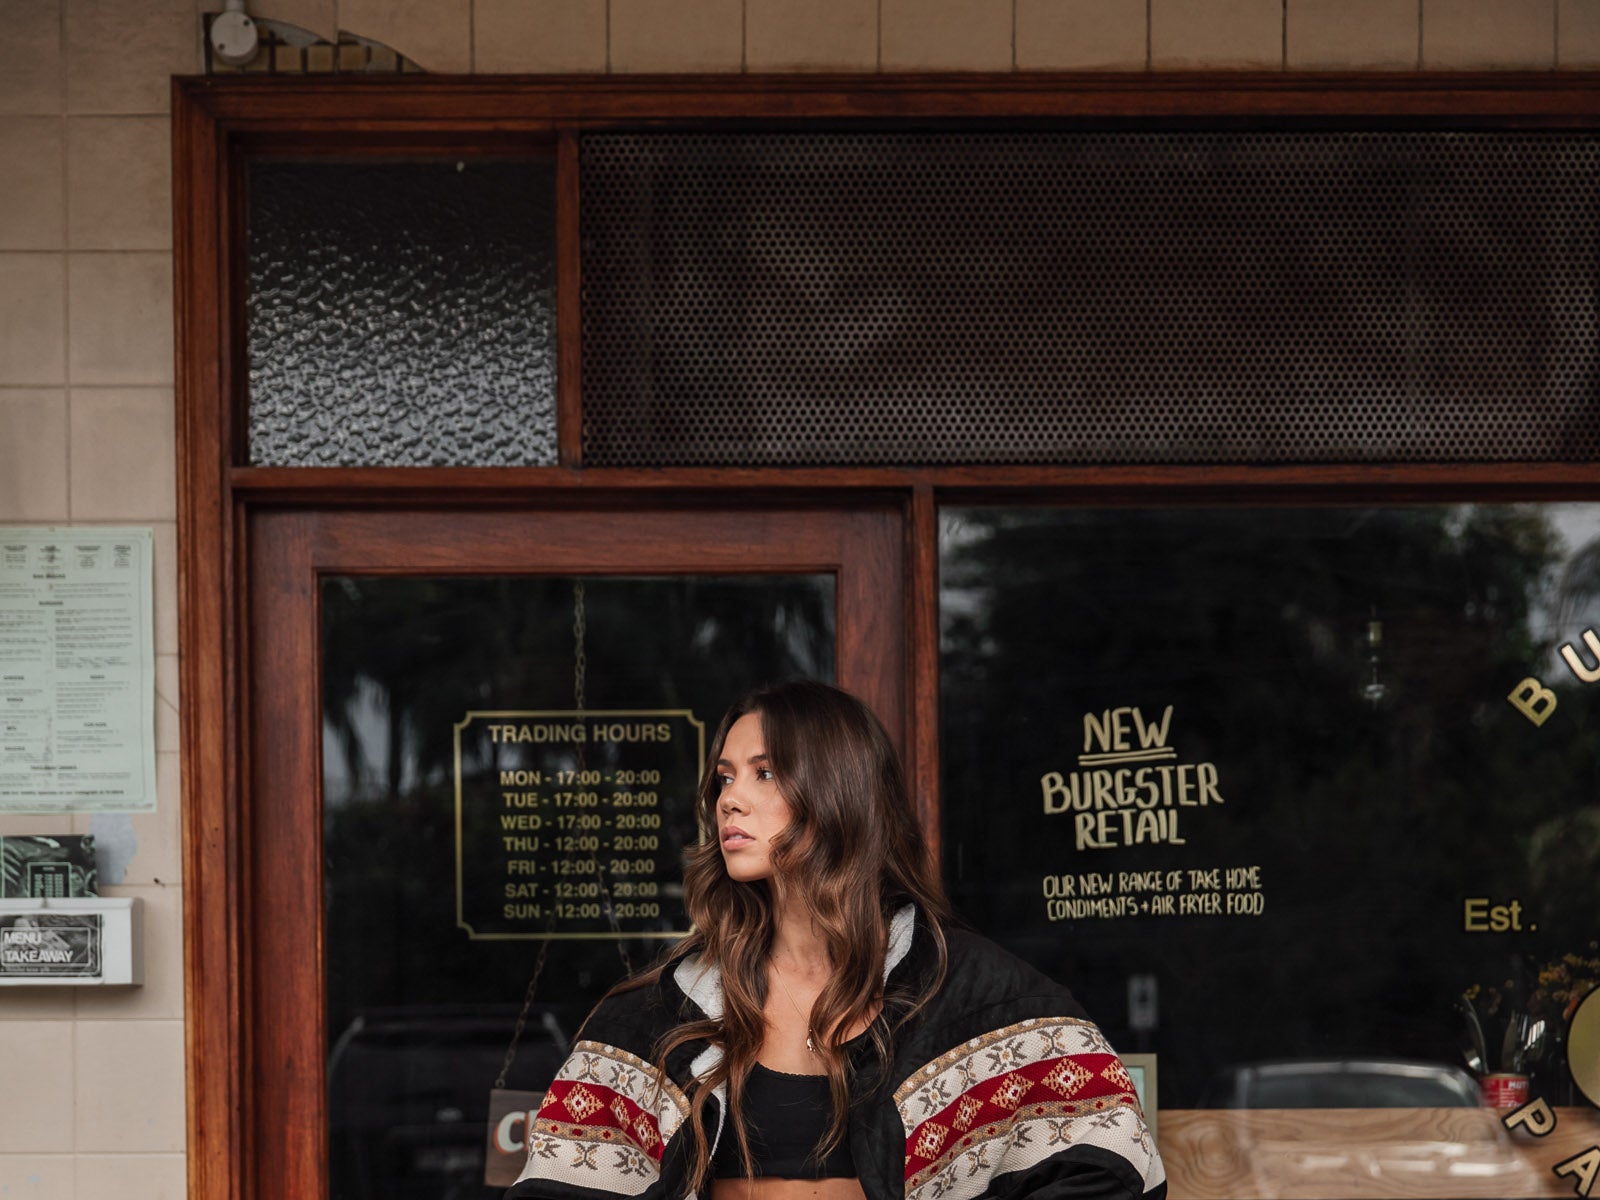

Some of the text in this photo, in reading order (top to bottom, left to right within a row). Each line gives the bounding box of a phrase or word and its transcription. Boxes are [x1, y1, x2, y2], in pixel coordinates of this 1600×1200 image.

[488, 723, 672, 743] TRADING HOURS
[1083, 705, 1174, 752] NEW
[500, 770, 541, 786] MON
[557, 769, 601, 786] 17:00
[615, 770, 660, 785] 20:00
[1041, 762, 1225, 814] BURGSTER
[503, 792, 538, 808] TUE
[554, 792, 598, 807] 17:00
[613, 792, 657, 806] 20:00
[501, 815, 541, 830] WED
[558, 815, 601, 829] 17:00
[616, 815, 660, 829] 20:00
[1074, 809, 1186, 850] RETAIL
[503, 837, 538, 851] THU
[556, 837, 598, 851] 12:00
[614, 836, 658, 850] 20:00
[507, 860, 535, 874] FRI
[552, 860, 595, 874] 12:00
[611, 860, 654, 873] 20:00
[505, 883, 538, 897] SAT
[555, 883, 598, 897] 12:00
[614, 883, 657, 896] 20:00
[1043, 866, 1261, 898] OUR NEW RANGE OF TAKE HOME
[504, 904, 540, 918] SUN
[556, 904, 600, 918] 12:00
[615, 904, 659, 917] 20:00
[1047, 894, 1138, 920] CONDIMENTS
[1152, 895, 1175, 914] AIR
[1180, 893, 1222, 914] FRYER
[1227, 893, 1264, 914] FOOD
[1465, 899, 1536, 931] Est.
[4, 931, 42, 946] MENU
[5, 950, 74, 963] TAKEAWAY
